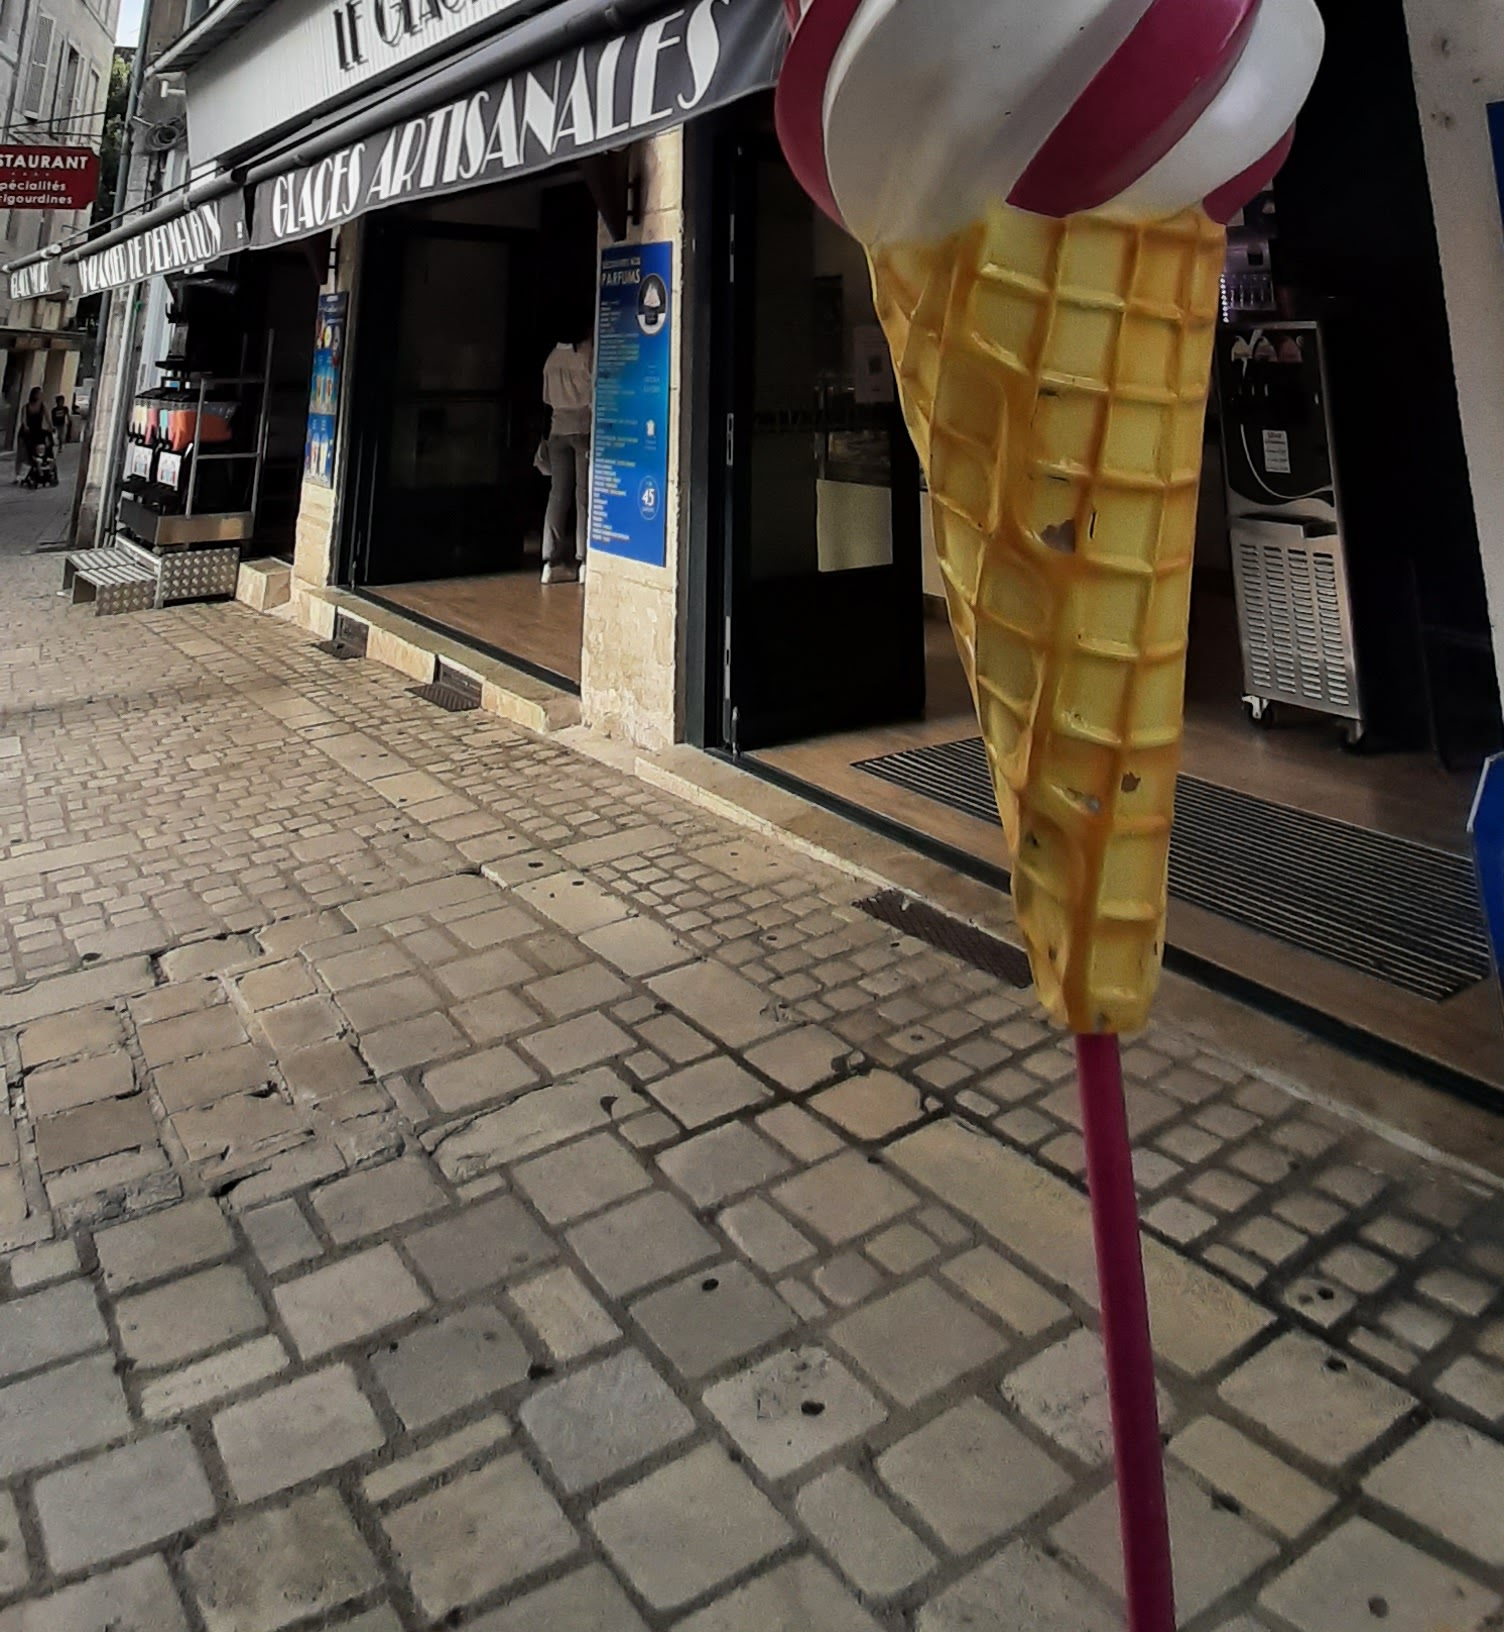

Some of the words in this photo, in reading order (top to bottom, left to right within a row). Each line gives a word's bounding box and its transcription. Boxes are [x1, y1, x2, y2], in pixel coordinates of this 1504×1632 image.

[271, 142, 367, 238] GLACES
[127, 235, 145, 280] DE
[602, 268, 641, 286] PARFUMS
